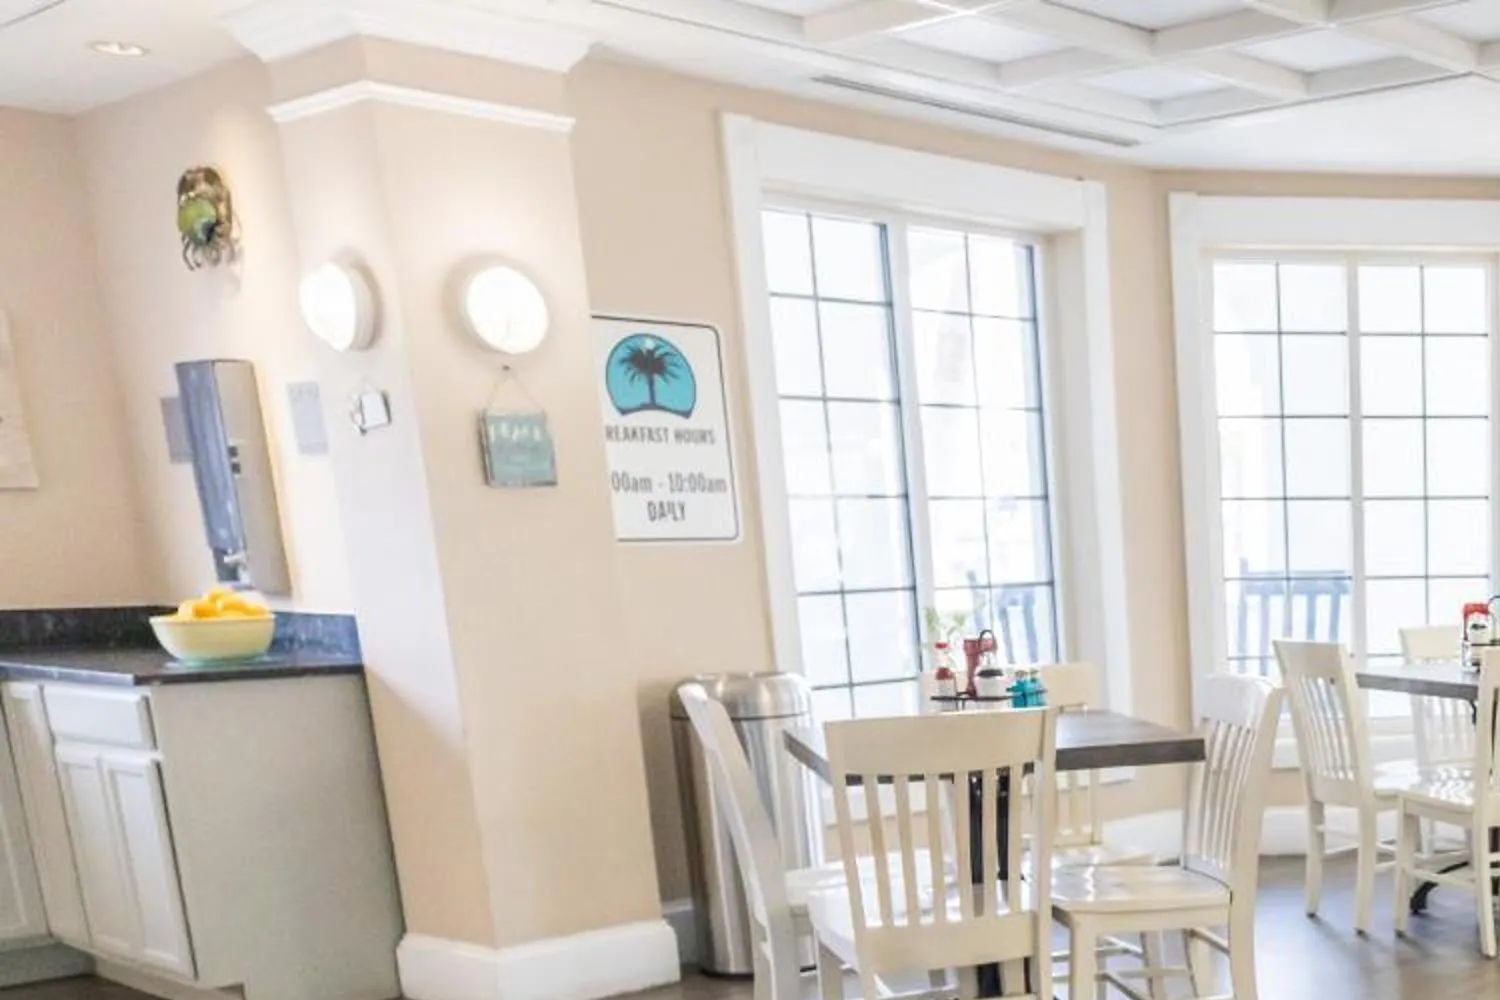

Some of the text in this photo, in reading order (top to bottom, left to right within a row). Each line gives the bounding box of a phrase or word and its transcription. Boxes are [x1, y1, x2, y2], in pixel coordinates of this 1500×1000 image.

[605, 425, 716, 445] REAKFAST HOURS
[611, 471, 653, 493] 00am
[668, 472, 727, 493] 10:00am
[647, 501, 686, 522] DAILY
